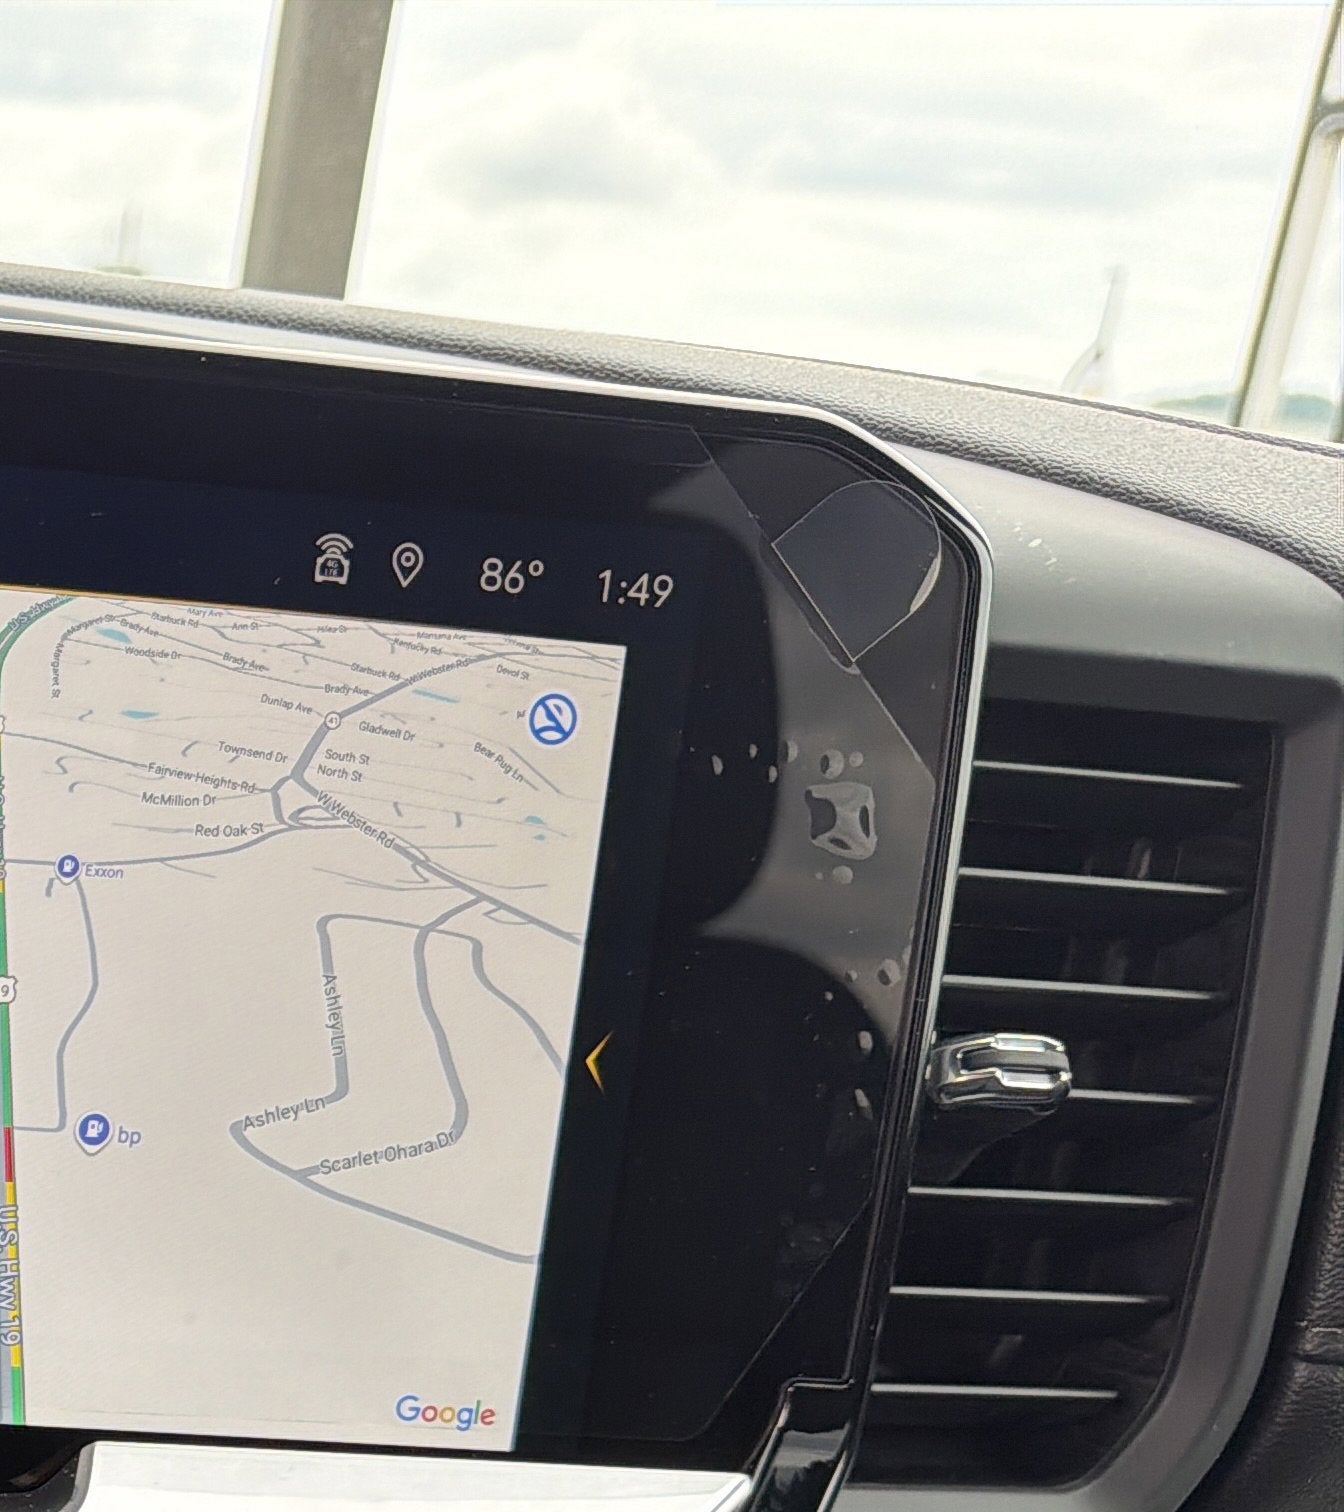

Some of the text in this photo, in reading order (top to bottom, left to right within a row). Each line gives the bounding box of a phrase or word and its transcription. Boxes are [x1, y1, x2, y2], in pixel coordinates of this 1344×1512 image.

[480, 557, 545, 594] 86°
[598, 568, 674, 608] 1:49
[51, 642, 64, 686] Margaret
[124, 646, 169, 660] Woodside
[223, 652, 248, 669] Brady
[324, 683, 370, 696] Brady Ave
[261, 693, 313, 714] Dunlap Ave
[359, 721, 415, 742] Gladwell Dr
[218, 740, 288, 764] Townsend Dr
[324, 749, 370, 766] South St
[473, 741, 495, 759] Bear
[511, 768, 524, 783] Ln
[148, 762, 256, 794] Fairview Heights Rd
[317, 764, 363, 783] North St
[141, 791, 217, 808] McMillion Dr
[195, 822, 265, 838] Red Oak St
[330, 799, 375, 837] Webster
[375, 830, 395, 849] Rd
[84, 863, 124, 880] Exxon
[322, 975, 346, 1057] Ashley Ln
[242, 1096, 326, 1132] Ashley Ln
[117, 1125, 142, 1147] bp
[319, 1130, 456, 1176] Scarlet Ohara Dr
[0, 1315, 21, 1346] 19
[395, 1395, 496, 1432] Google
